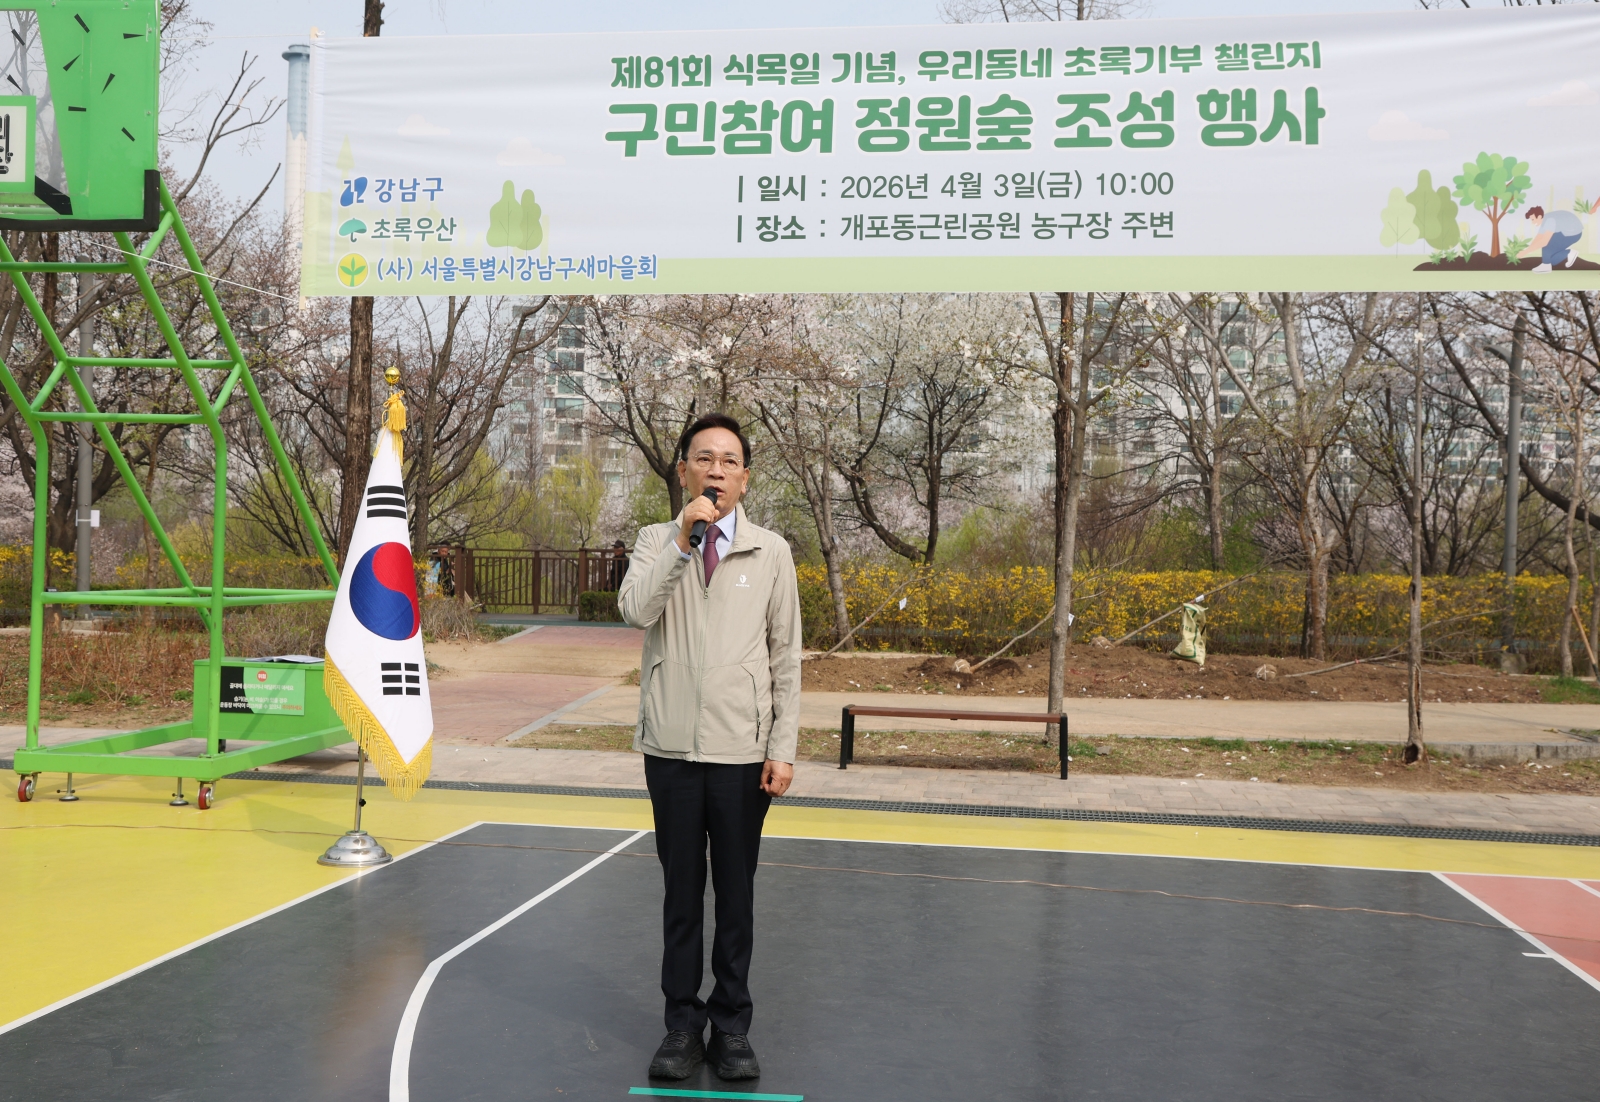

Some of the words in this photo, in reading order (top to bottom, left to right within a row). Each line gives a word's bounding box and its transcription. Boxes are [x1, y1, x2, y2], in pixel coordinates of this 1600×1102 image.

[611, 55, 711, 88] 제81회
[723, 53, 819, 86] 식목일
[832, 51, 905, 85] 기념,
[918, 48, 1052, 81] 우리동네
[1064, 45, 1202, 76] 초록기부
[1215, 41, 1321, 71] 챌린지
[605, 99, 834, 157] 구민참여
[856, 94, 1033, 152] 정원숲
[1054, 90, 1174, 148] 조성
[1197, 87, 1326, 146] 행사
[375, 178, 443, 203] 강남구
[758, 175, 805, 201] 일시
[841, 174, 928, 199] 2026년
[941, 172, 981, 198] 4월
[994, 170, 1082, 199] 3일(금)
[1097, 172, 1173, 195] 10:00
[371, 217, 457, 241] 초록우산
[756, 215, 806, 242] 장소
[841, 212, 1020, 240] 개포동근린공원
[1032, 212, 1112, 239] 농구장
[1122, 211, 1173, 238] 주변
[378, 258, 412, 281] (사)
[421, 254, 656, 281] 서울특별시강남구새마을회
